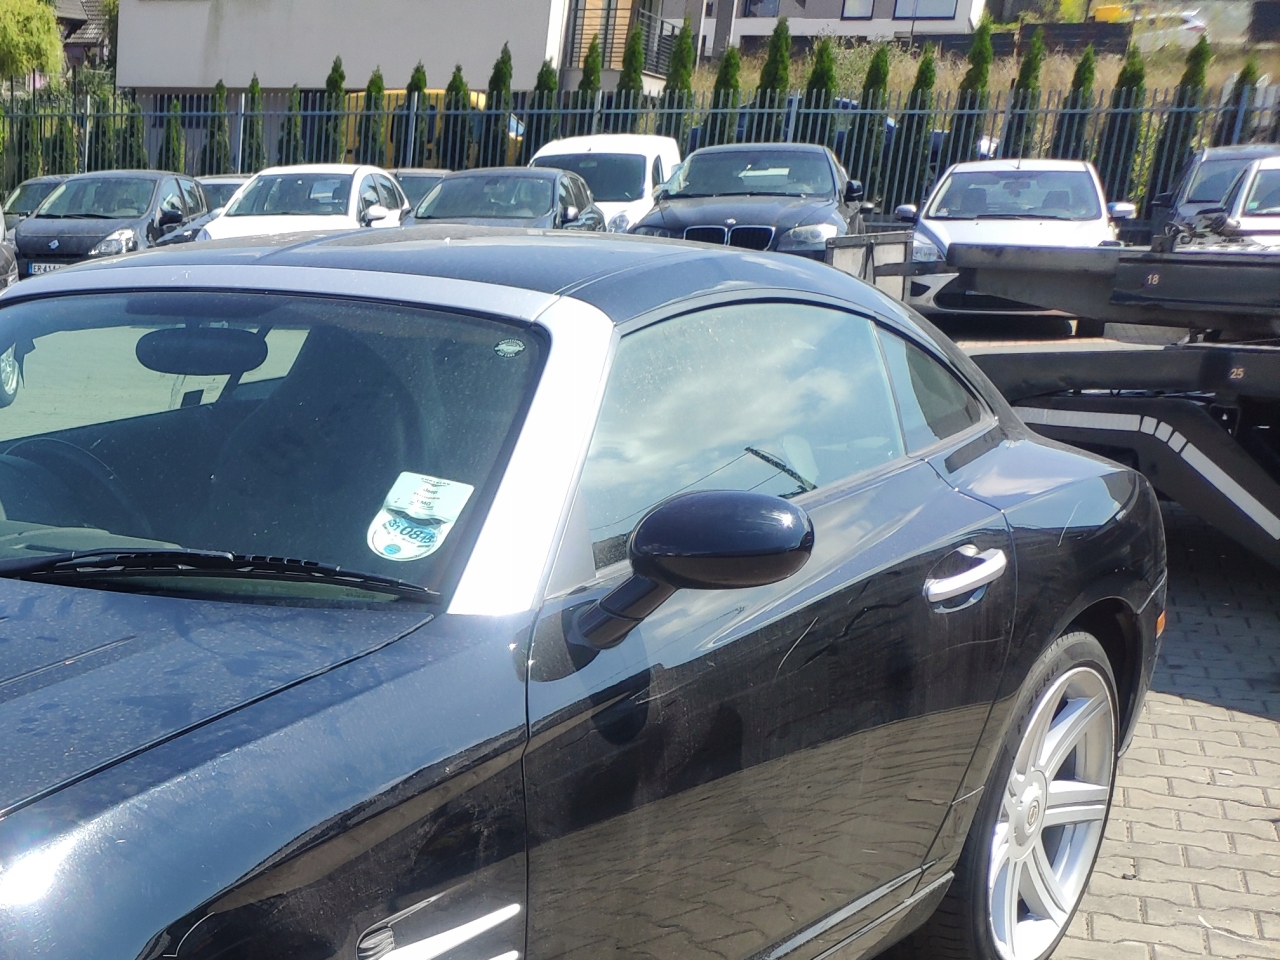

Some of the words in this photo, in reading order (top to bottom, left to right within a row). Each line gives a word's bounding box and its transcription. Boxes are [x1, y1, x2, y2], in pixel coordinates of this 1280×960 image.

[1147, 274, 1159, 285] 18
[1230, 368, 1245, 379] 25
[400, 526, 423, 539] 08
